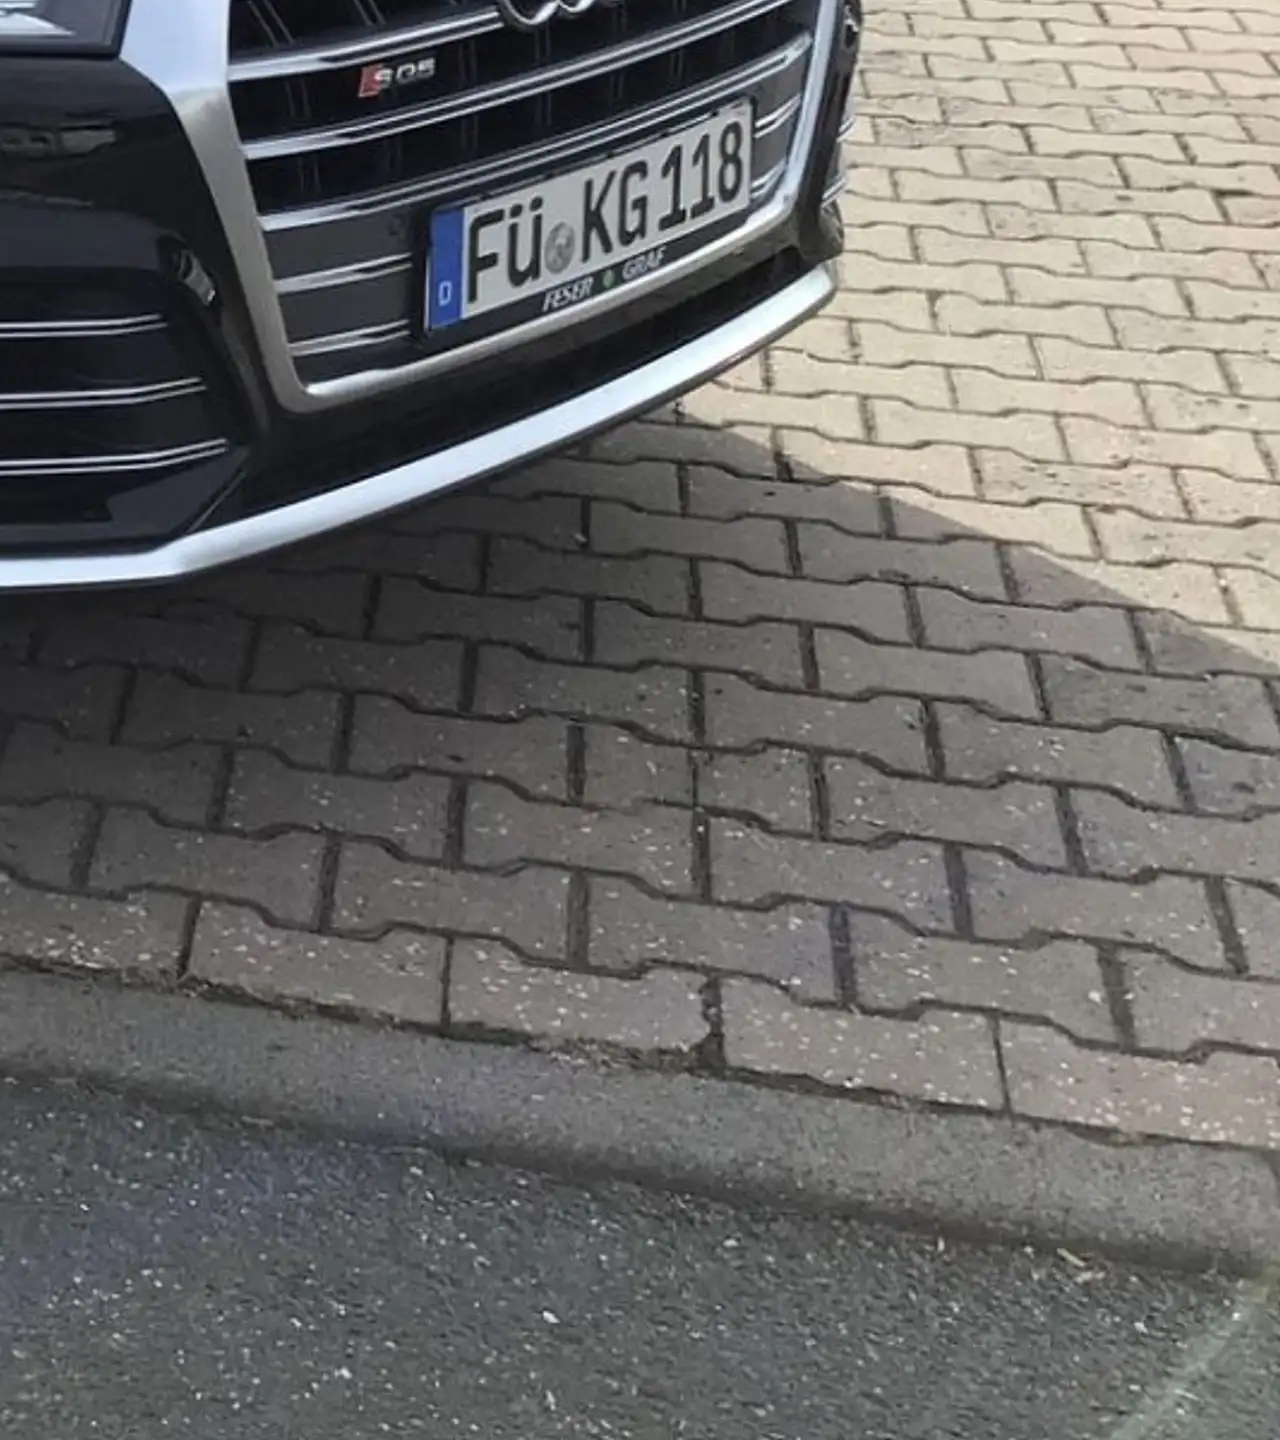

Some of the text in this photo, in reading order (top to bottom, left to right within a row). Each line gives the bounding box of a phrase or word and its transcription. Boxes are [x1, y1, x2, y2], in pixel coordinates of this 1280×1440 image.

[467, 121, 744, 304] FÜ KG 118
[439, 280, 452, 306] D
[541, 276, 595, 311] FESER
